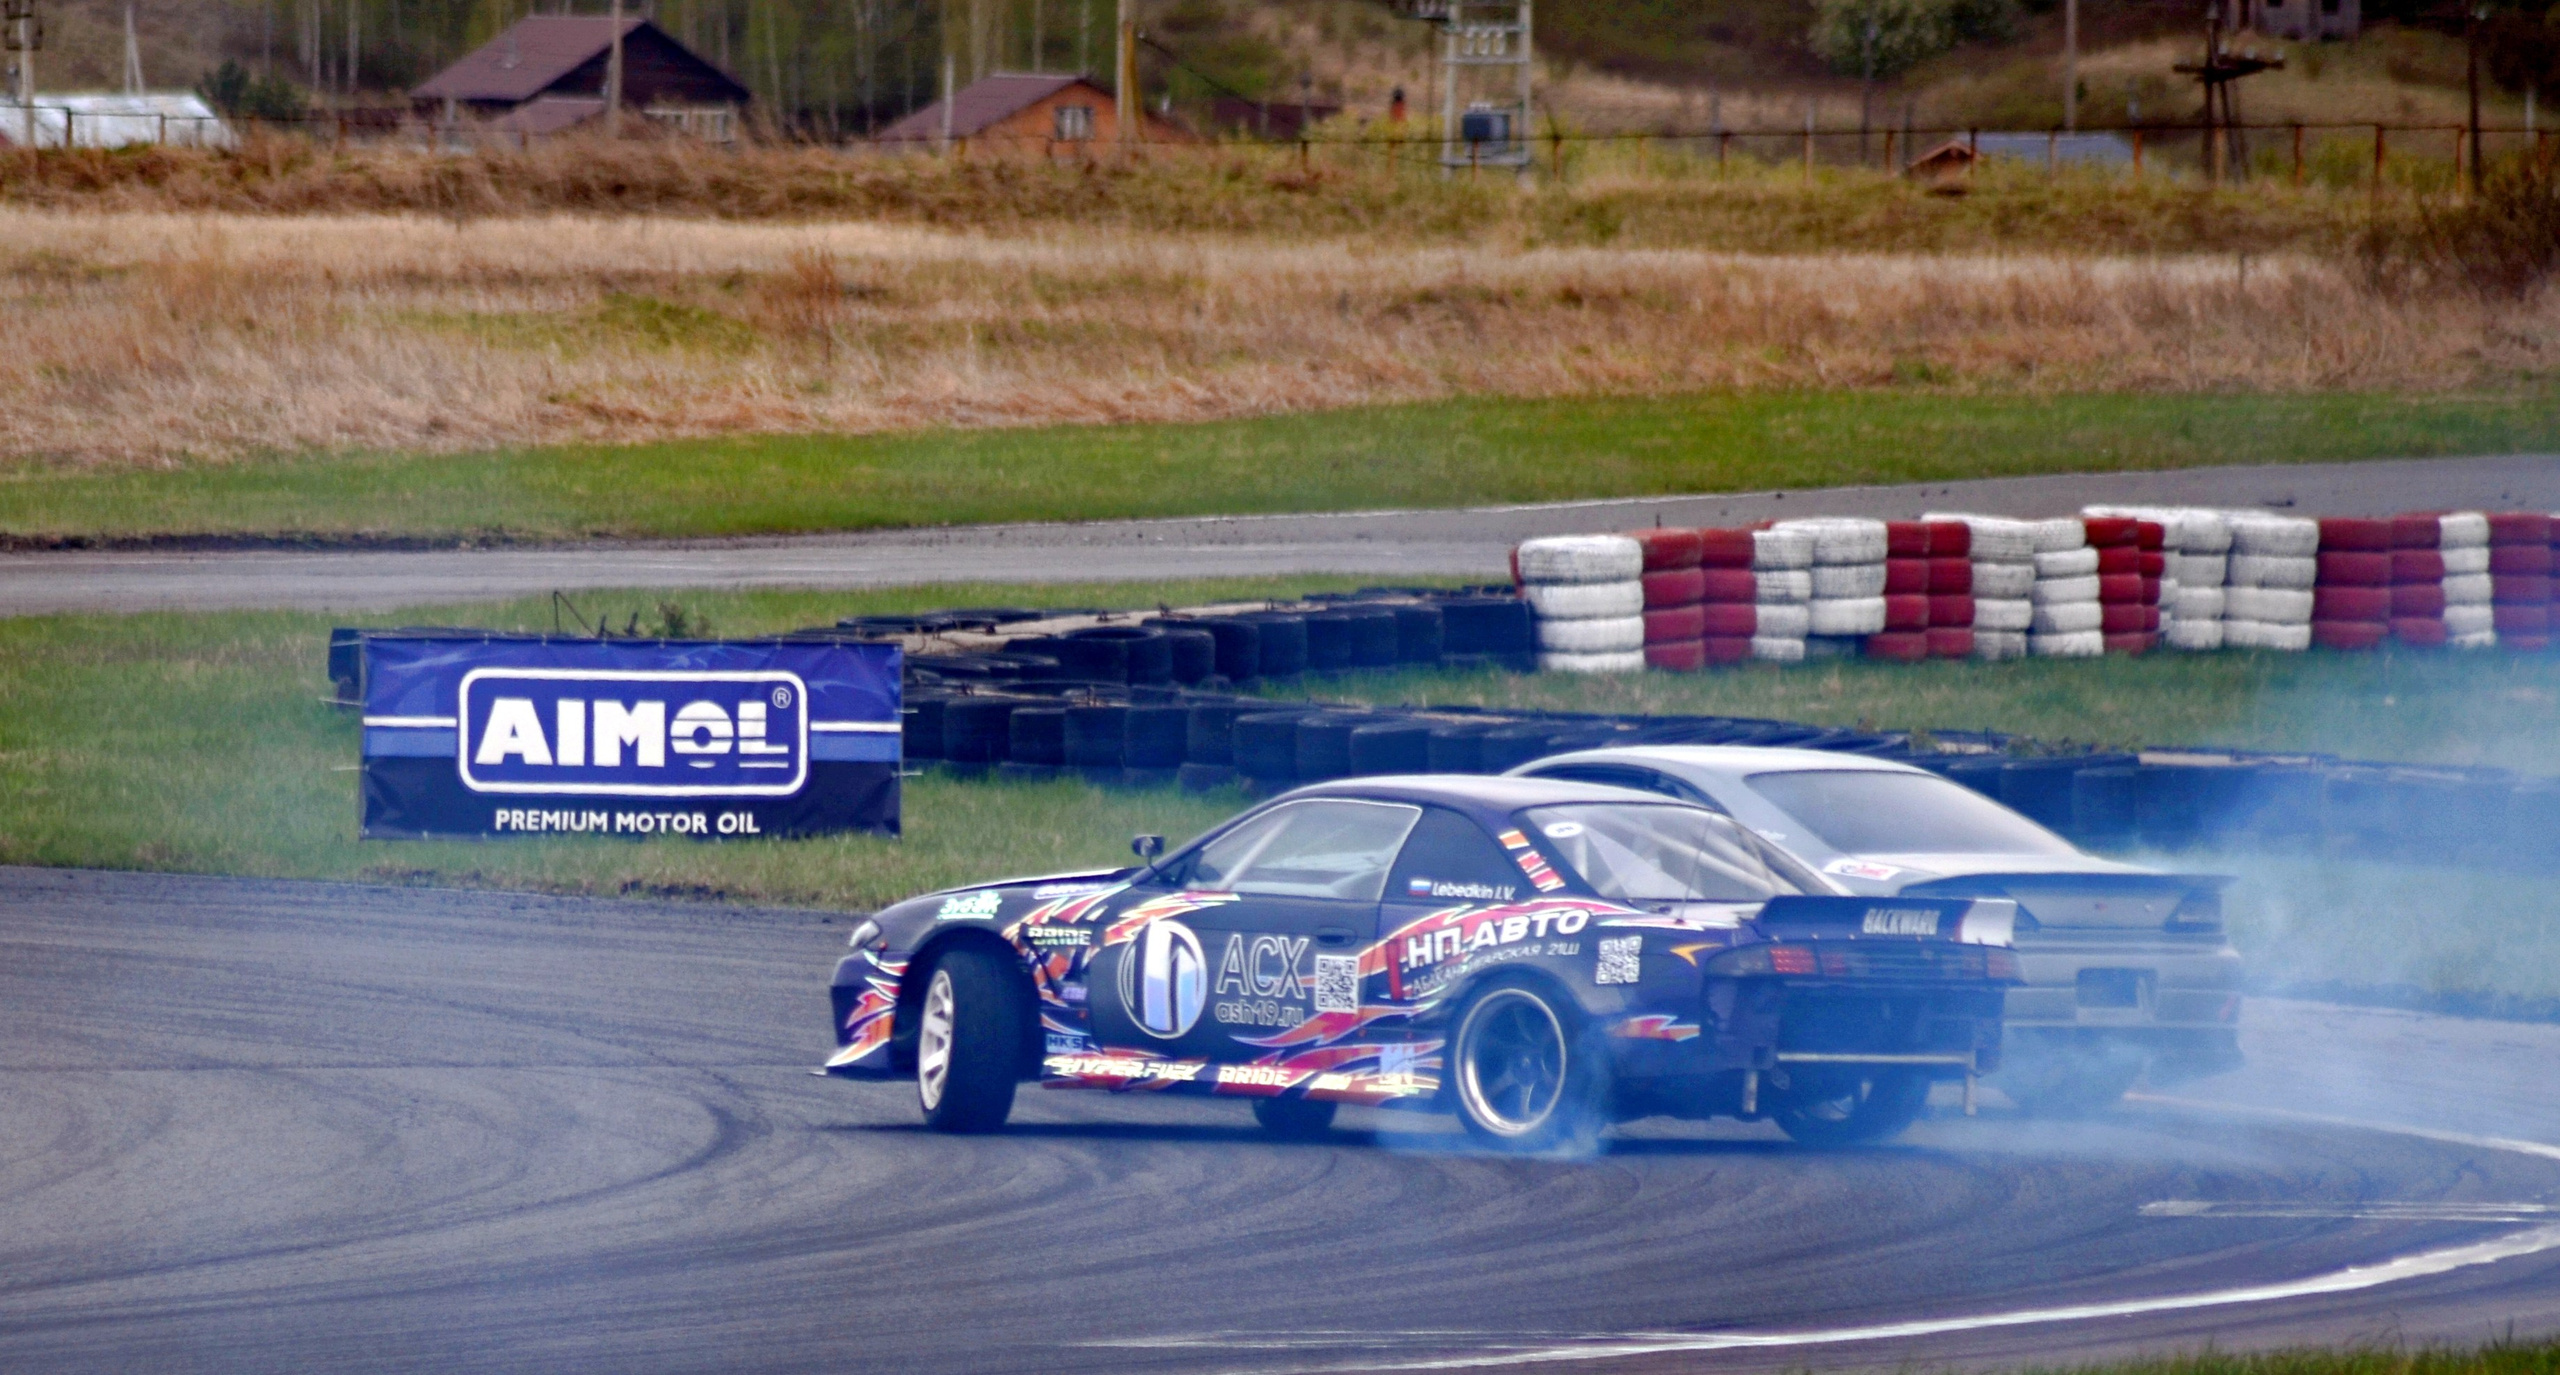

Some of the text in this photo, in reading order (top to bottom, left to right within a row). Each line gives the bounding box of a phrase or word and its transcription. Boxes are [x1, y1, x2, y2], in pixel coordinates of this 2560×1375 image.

[475, 698, 789, 767] AIMOL
[495, 808, 760, 833] PREMIUM MOTOR OIL
[1028, 927, 1092, 946] BRIDE
[1215, 1000, 1305, 1028] ash19.ru
[1050, 1037, 1082, 1049] HKS
[1218, 1066, 1292, 1087] BRIDE
